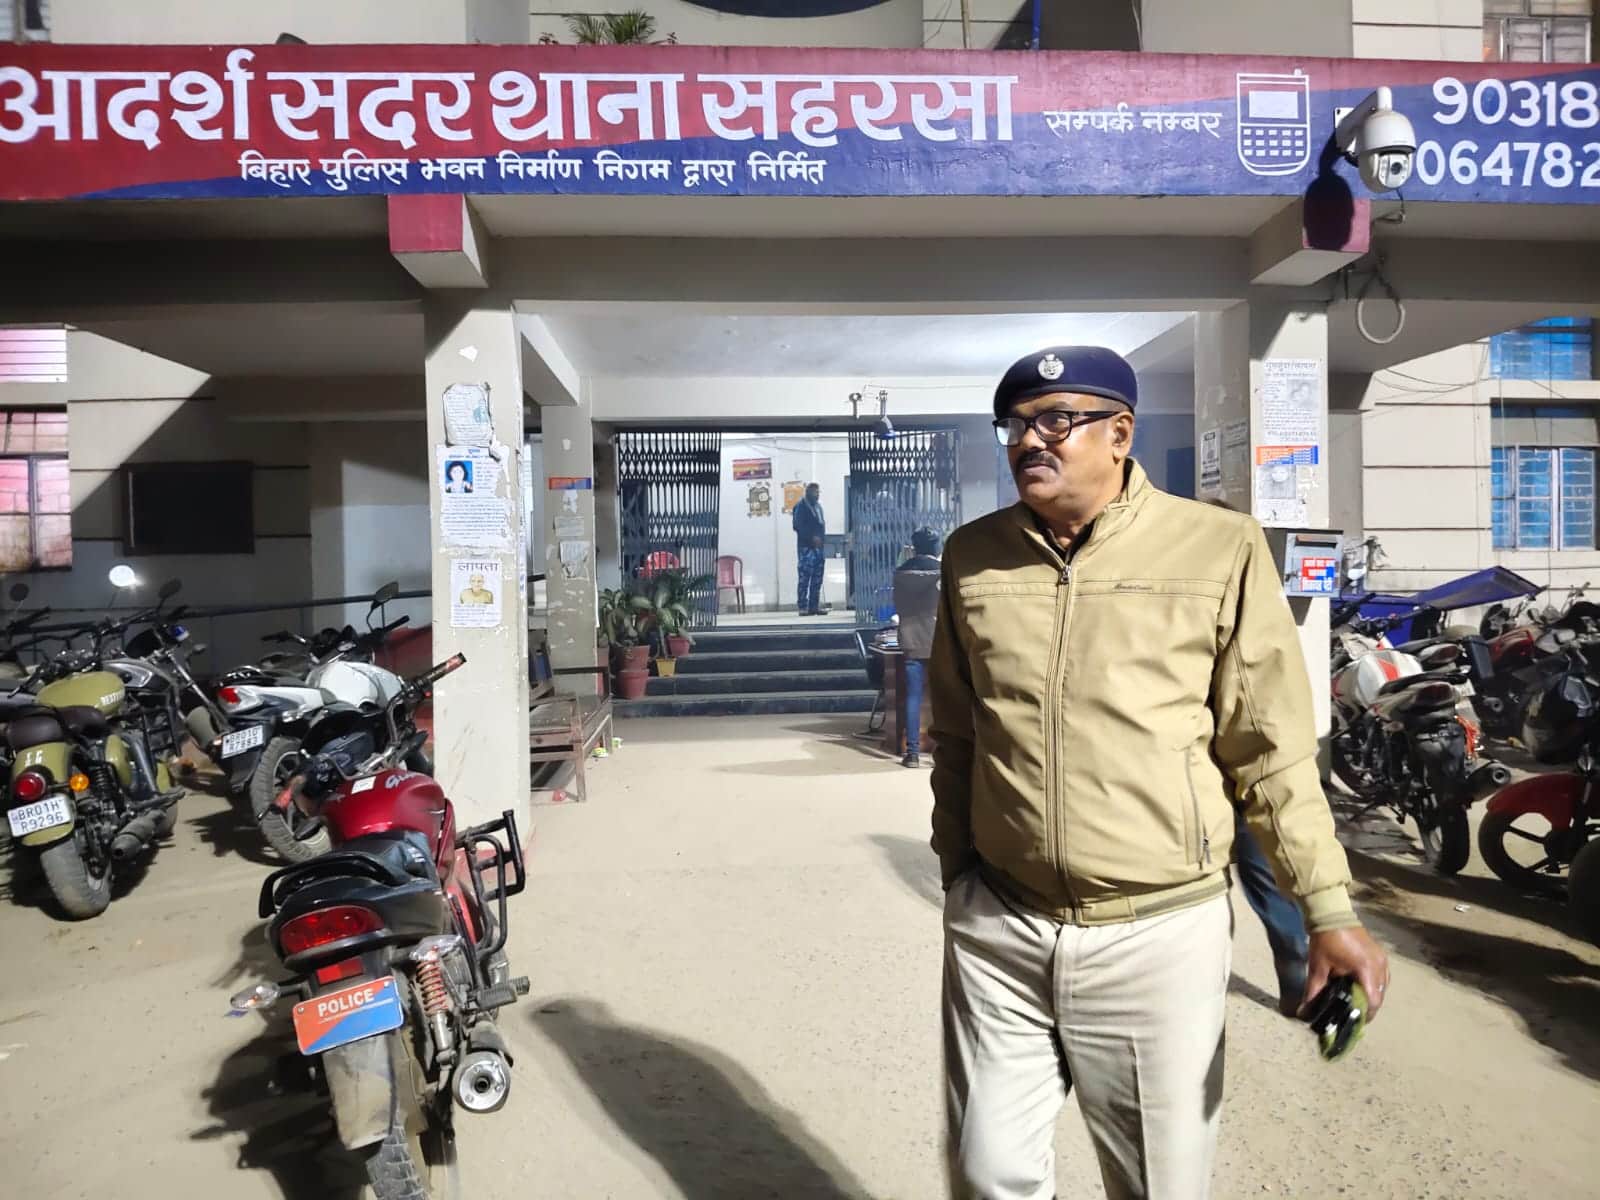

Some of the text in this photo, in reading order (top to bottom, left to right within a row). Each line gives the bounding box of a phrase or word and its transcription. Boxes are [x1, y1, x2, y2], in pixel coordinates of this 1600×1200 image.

[0, 48, 1019, 150] आदर्श सदर थाना सहरसा
[1432, 76, 1600, 129] 90318
[1042, 101, 1223, 140] सम्पर्क नम्बर
[238, 148, 827, 191] बिहार पुलिस भवन निर्माण निगम द्वारा निर्मित
[17, 801, 60, 821] BR01H
[20, 811, 63, 832] R9296
[317, 988, 375, 1018] POLICE
